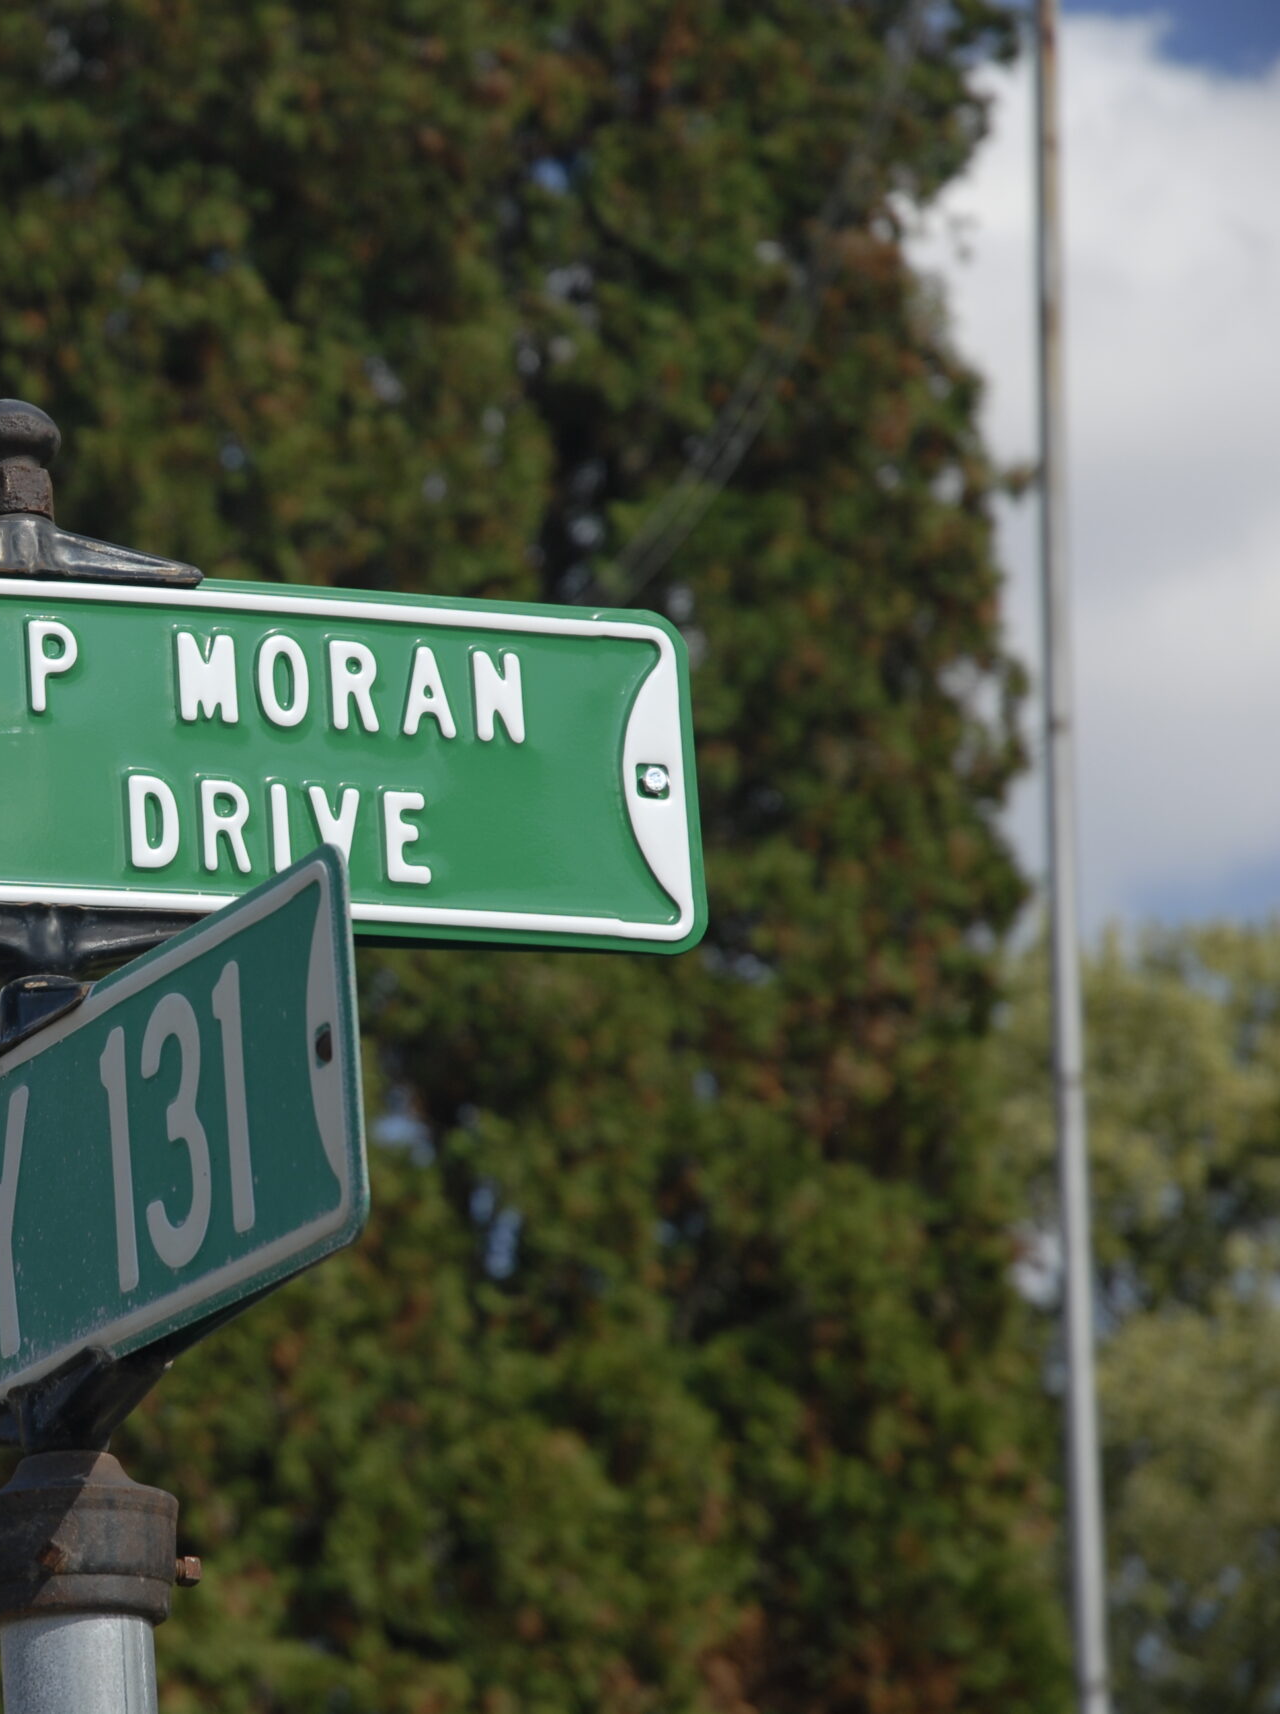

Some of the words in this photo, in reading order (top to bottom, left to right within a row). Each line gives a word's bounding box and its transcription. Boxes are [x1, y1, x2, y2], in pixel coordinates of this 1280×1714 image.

[27, 619, 78, 712] P
[176, 631, 526, 744] MORAN
[128, 774, 432, 884] DRIVE
[99, 960, 256, 1293] 131
